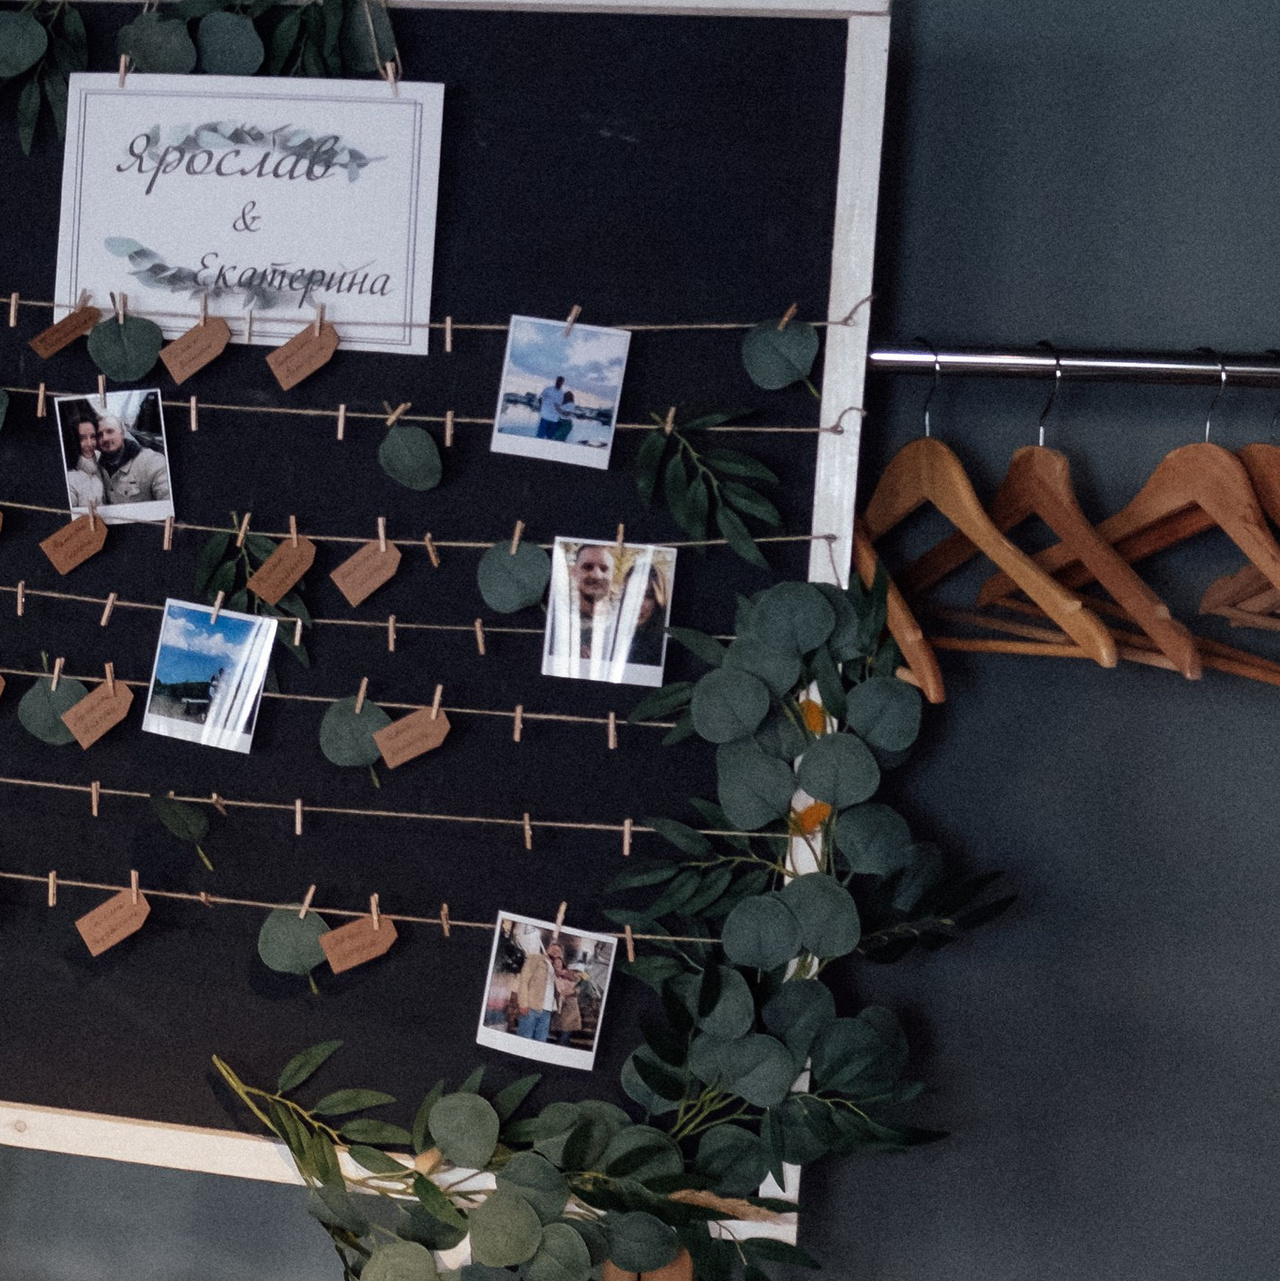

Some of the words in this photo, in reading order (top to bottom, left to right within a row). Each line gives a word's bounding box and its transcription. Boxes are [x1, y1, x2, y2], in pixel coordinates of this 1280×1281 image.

[116, 132, 341, 196] Ярослав
[232, 200, 262, 233] &
[193, 251, 394, 309] Екатерина
